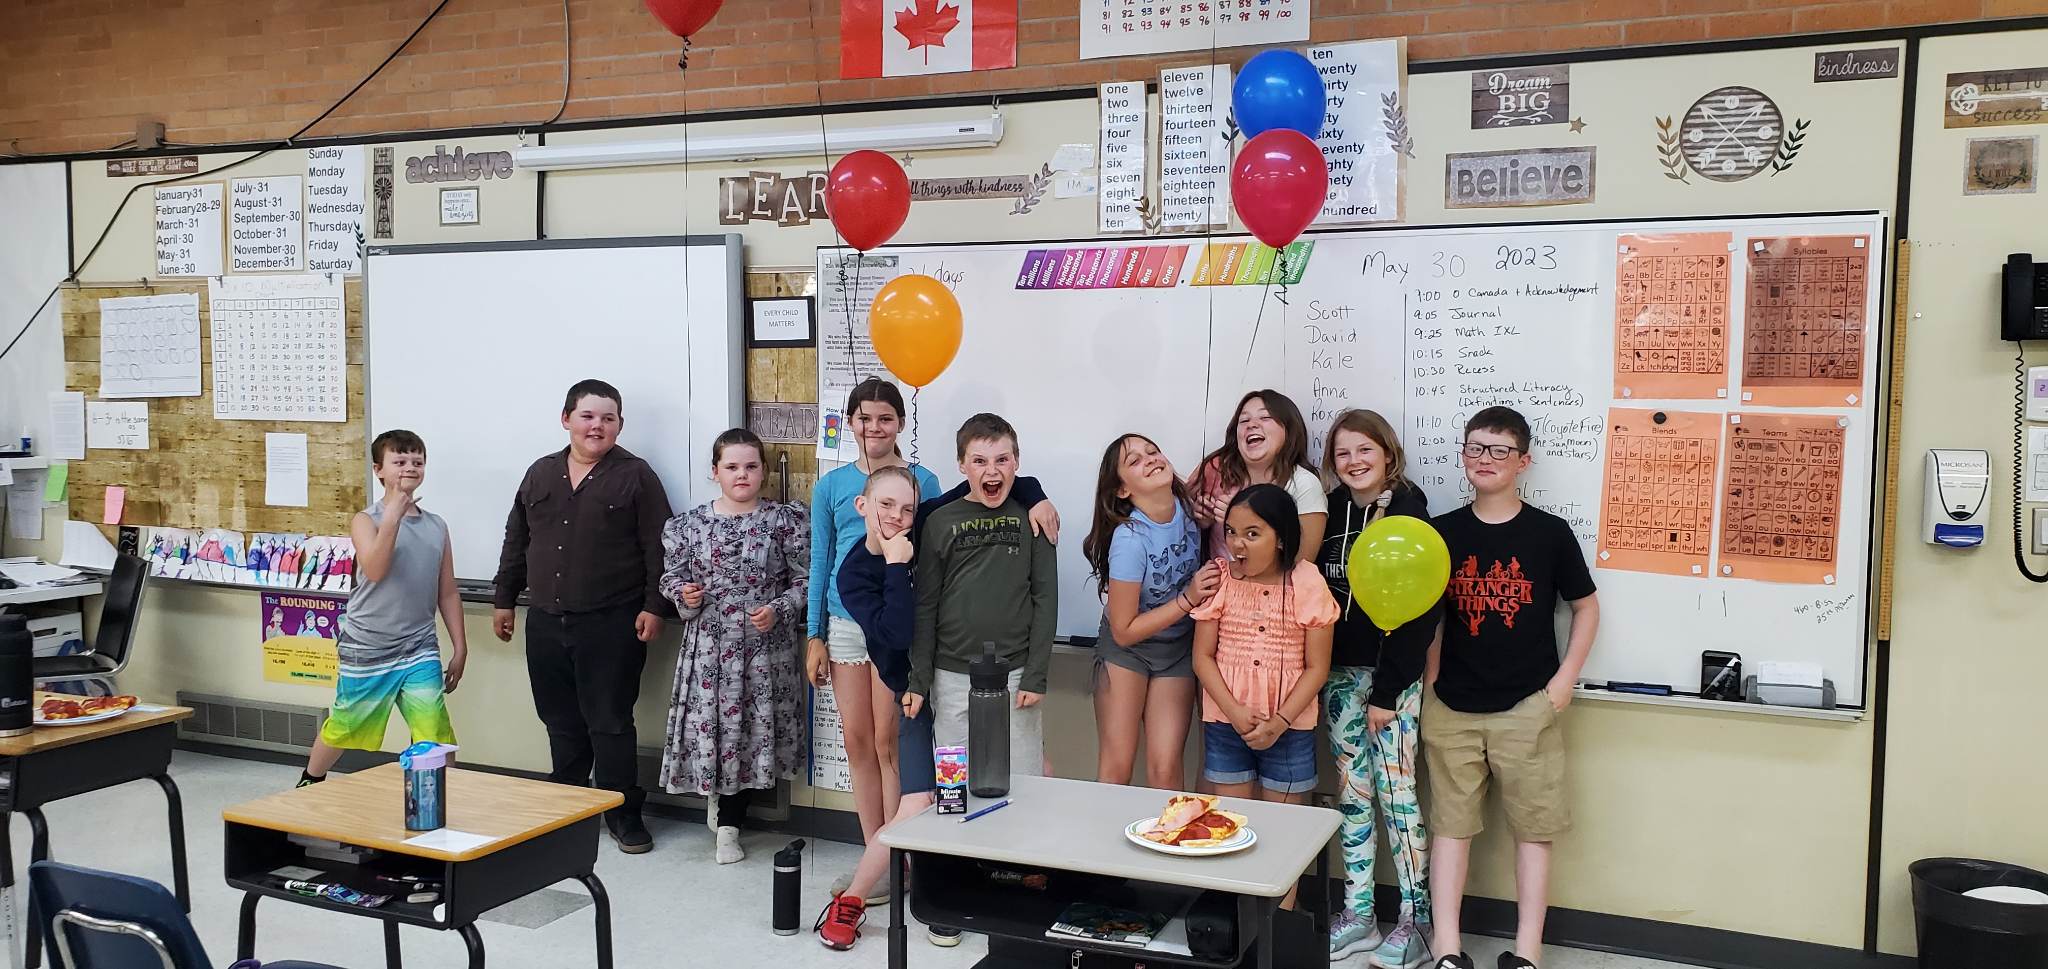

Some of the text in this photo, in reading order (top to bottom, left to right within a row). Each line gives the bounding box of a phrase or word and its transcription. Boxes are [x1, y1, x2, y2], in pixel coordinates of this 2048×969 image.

[1122, 10, 1134, 18] 82
[1141, 8, 1152, 16] 83
[1159, 6, 1171, 15] 84
[1180, 5, 1192, 13] 85
[1198, 3, 1209, 12] 86
[1219, 1, 1231, 9] 87
[1101, 10, 1291, 34] 91 92 93 94 95 96 97 98 99 100
[1312, 48, 1333, 59] ten
[1317, 63, 1357, 75] wenty
[1818, 52, 1895, 76] kindness
[1164, 72, 1204, 82] eleven
[1488, 72, 1552, 95] Dream
[1106, 85, 1129, 94] one
[1165, 87, 1204, 98] twelve
[1107, 99, 1129, 108] two
[1498, 91, 1551, 113] BIG
[1166, 103, 1213, 115] thirteen
[1108, 113, 1139, 123] three
[1973, 108, 2041, 124] success
[1165, 119, 1216, 130] fourteen
[1107, 128, 1131, 138] four
[1164, 134, 1202, 146] fifteen
[309, 148, 344, 160] Sunday
[1106, 143, 1128, 153] five
[1322, 143, 1365, 155] eventy
[1164, 150, 1207, 160] sixteen
[405, 145, 514, 184] achieve
[1106, 158, 1122, 168] six
[308, 165, 345, 178] Monday
[1164, 165, 1226, 176] seventeen
[1106, 174, 1140, 183] seven
[1457, 159, 1584, 198] Believe
[234, 182, 269, 195] July-31
[308, 184, 348, 197] Tuesday
[920, 181, 952, 197] things
[954, 180, 976, 195] with
[979, 178, 1025, 193] kindness
[1163, 180, 1215, 192] eighteen
[1106, 187, 1136, 200] eight
[234, 197, 282, 210] August-31
[1163, 196, 1215, 206] nineteen
[308, 202, 365, 214] Wednesday
[1106, 203, 1131, 213] nine
[1323, 204, 1377, 216] hundred
[234, 211, 301, 225] September-30
[1106, 218, 1124, 228] ten
[1163, 211, 1202, 223] twenty
[156, 218, 199, 230] March-31
[308, 221, 353, 233] Thursday
[234, 227, 287, 239] October-31
[234, 243, 296, 255] November-30
[308, 239, 339, 251] Friday
[1793, 247, 1828, 257] Syllables
[309, 258, 353, 271] Saturday
[1058, 254, 1074, 286] Hundred
[1066, 250, 1084, 286] thousands
[1085, 249, 1103, 286] thousands
[1100, 248, 1119, 286] Thousands
[1121, 250, 1139, 285] Hundreds
[1219, 246, 1239, 282] Hundredths
[1362, 245, 1557, 284] May 30 2023
[934, 260, 965, 292] days
[1027, 259, 1041, 287] millions
[1041, 259, 1056, 287] Millions
[1141, 268, 1153, 285] Tens
[1162, 264, 1174, 285] Ones
[1018, 274, 1027, 287] Ten
[1076, 274, 1086, 286] Ten
[1468, 287, 1509, 297] Canada
[764, 309, 799, 318] EVERY CHILD
[1307, 300, 1355, 320] Scott
[1448, 306, 1502, 320] Journal
[768, 320, 795, 329] MATTERS
[1304, 325, 1357, 344] David
[1414, 325, 1521, 339] 9:25 Math IXL
[1311, 349, 1354, 369] Kale
[1412, 345, 1494, 360] 10:15 Snack
[1413, 364, 1496, 379] 10:30 Recess
[1313, 376, 1349, 399] Anna
[1415, 381, 1574, 400] 10:45 Structured Literacy
[752, 406, 818, 439] READ
[1416, 415, 1442, 429] 11:10
[1652, 427, 1677, 435] Blends
[1763, 429, 1788, 437] Teams
[1418, 437, 1446, 446] 12:00
[1546, 449, 1564, 457] and
[1419, 455, 1449, 466] 12:45
[1422, 475, 1445, 486] 1:10
[952, 515, 1021, 536] UNDER
[957, 532, 1021, 549] ARMOUR
[265, 596, 279, 605] The
[280, 597, 336, 610] ROUNDING
[1457, 595, 1520, 612] THINGS
